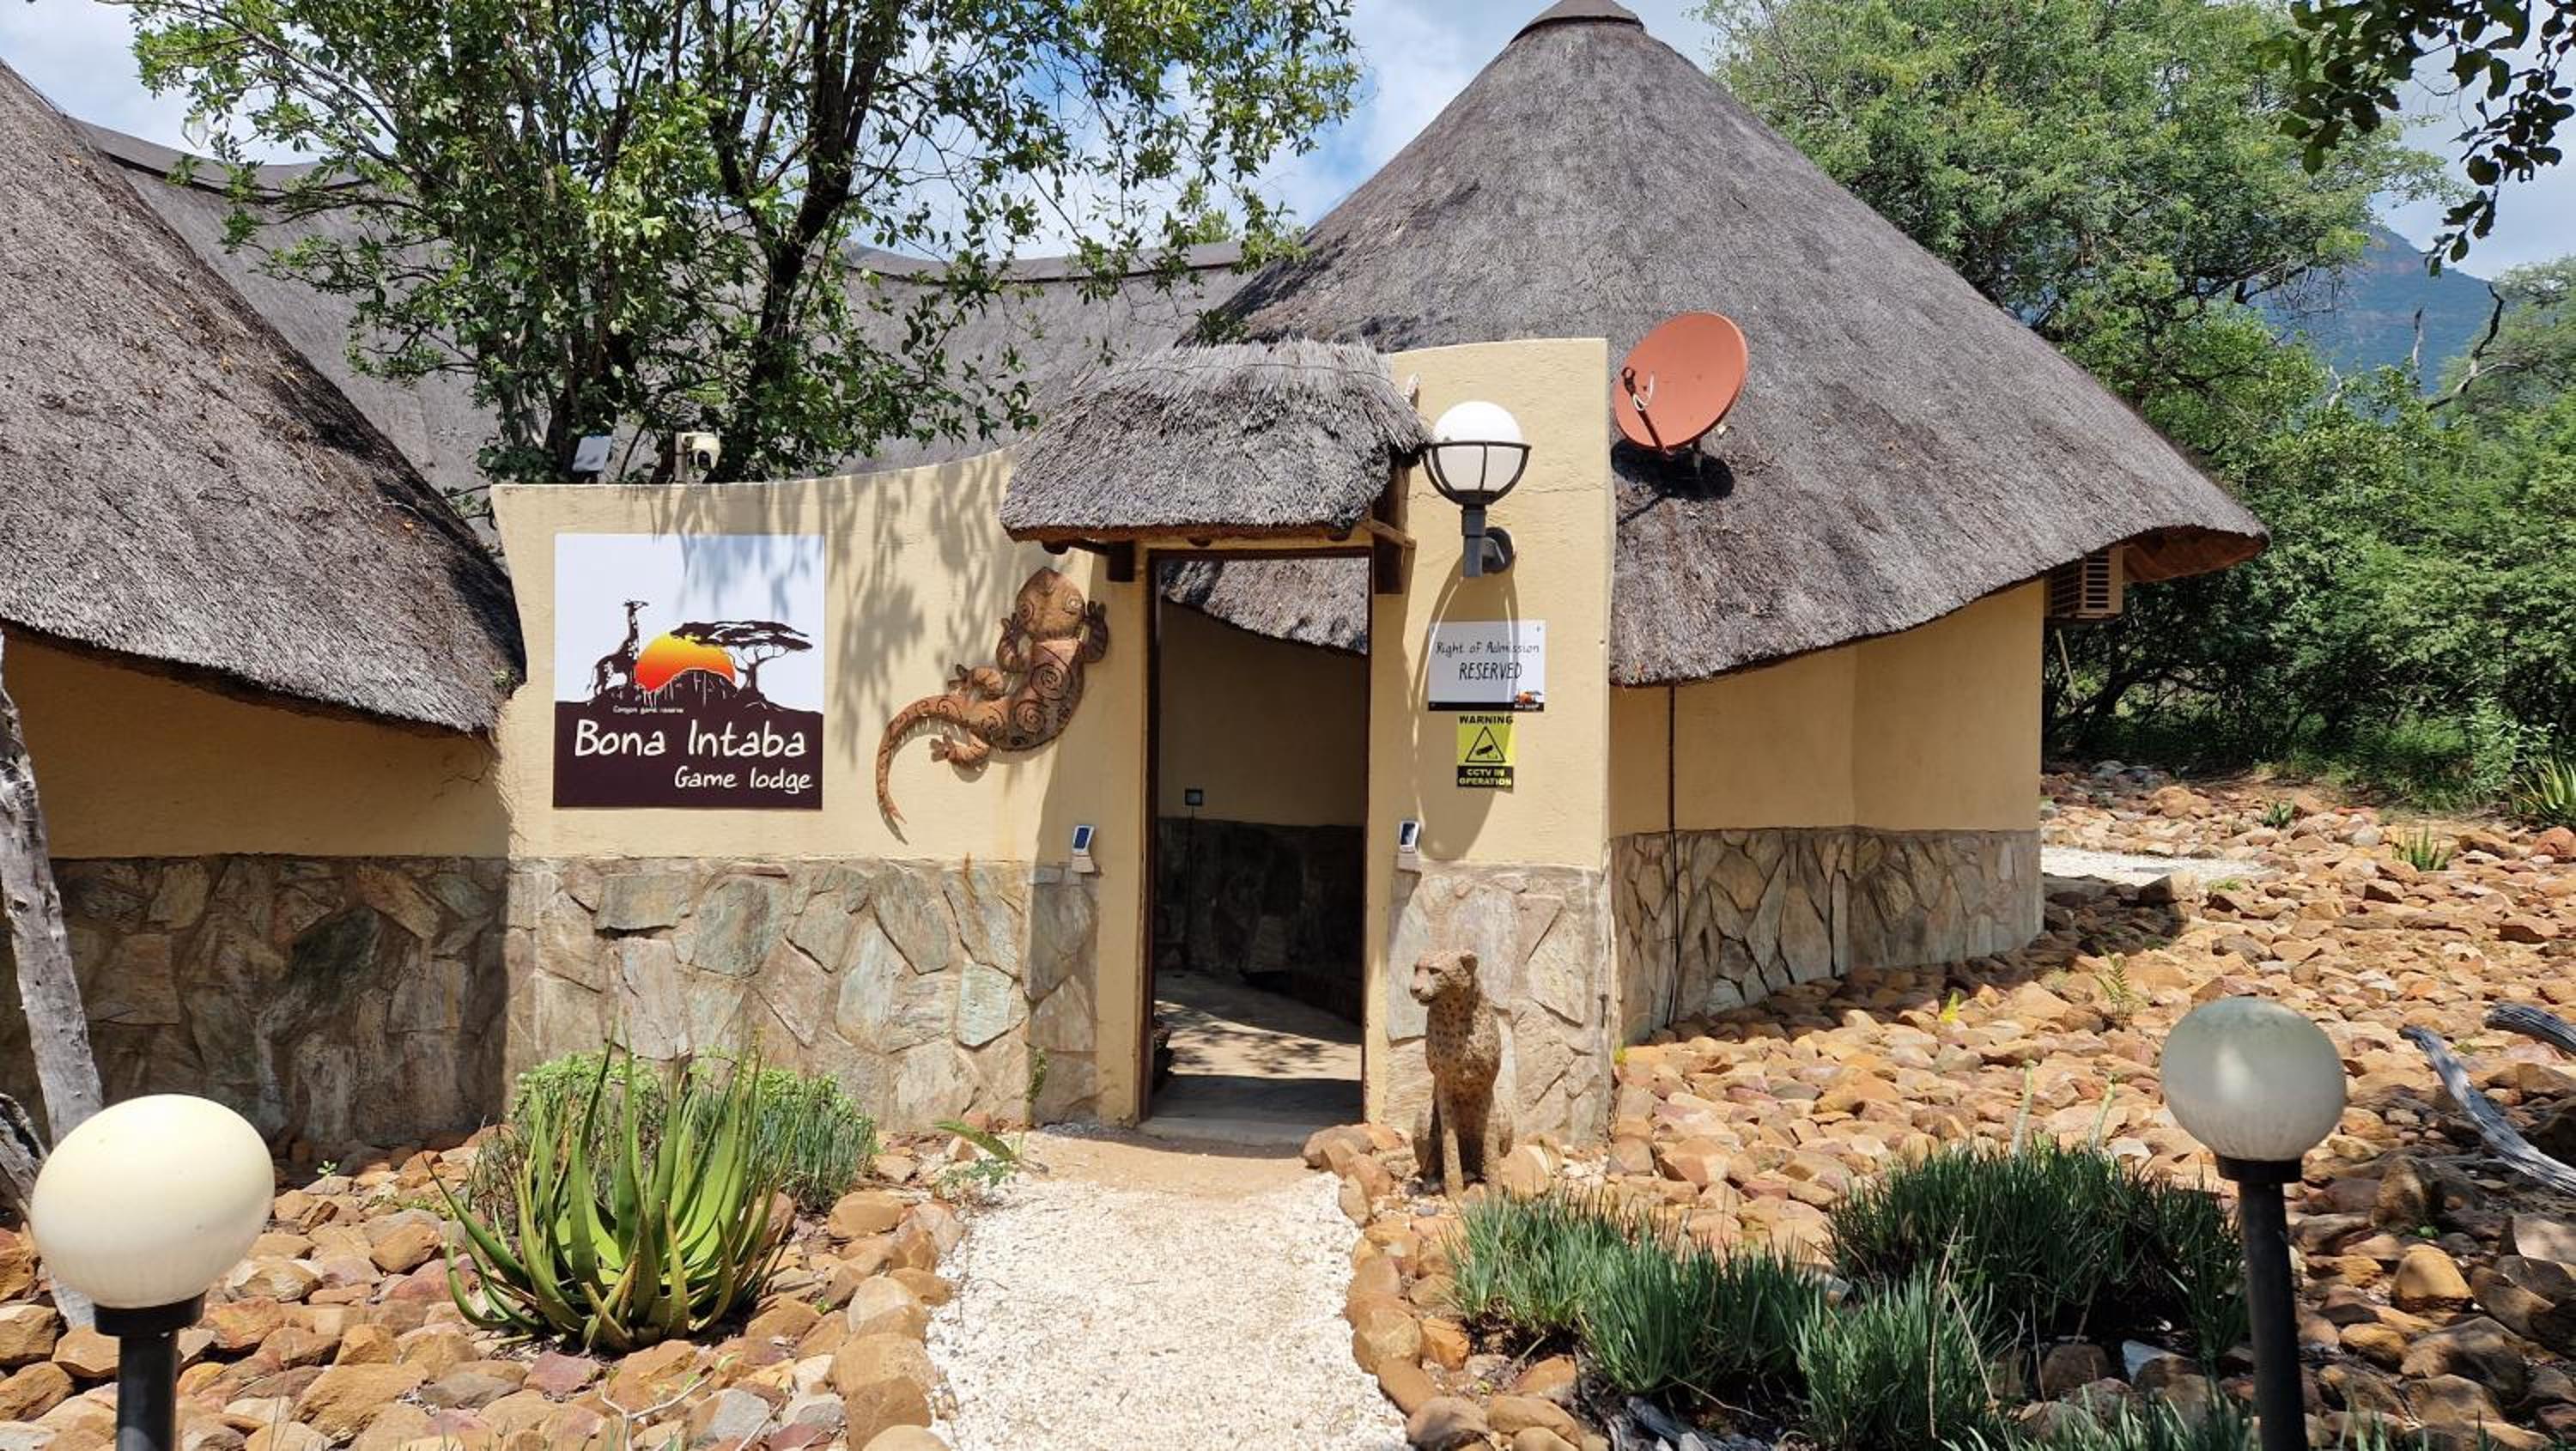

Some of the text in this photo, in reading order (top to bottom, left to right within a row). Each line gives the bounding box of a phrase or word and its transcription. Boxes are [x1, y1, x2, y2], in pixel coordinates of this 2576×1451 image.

[1436, 641, 1463, 658] Right
[1486, 641, 1540, 653] Admission
[1459, 662, 1522, 680] RESERVED
[1459, 715, 1514, 725] WARNING
[575, 719, 806, 757] Bona Intaba
[674, 765, 813, 793] Game lodge
[1459, 777, 1512, 786] OPERATION
